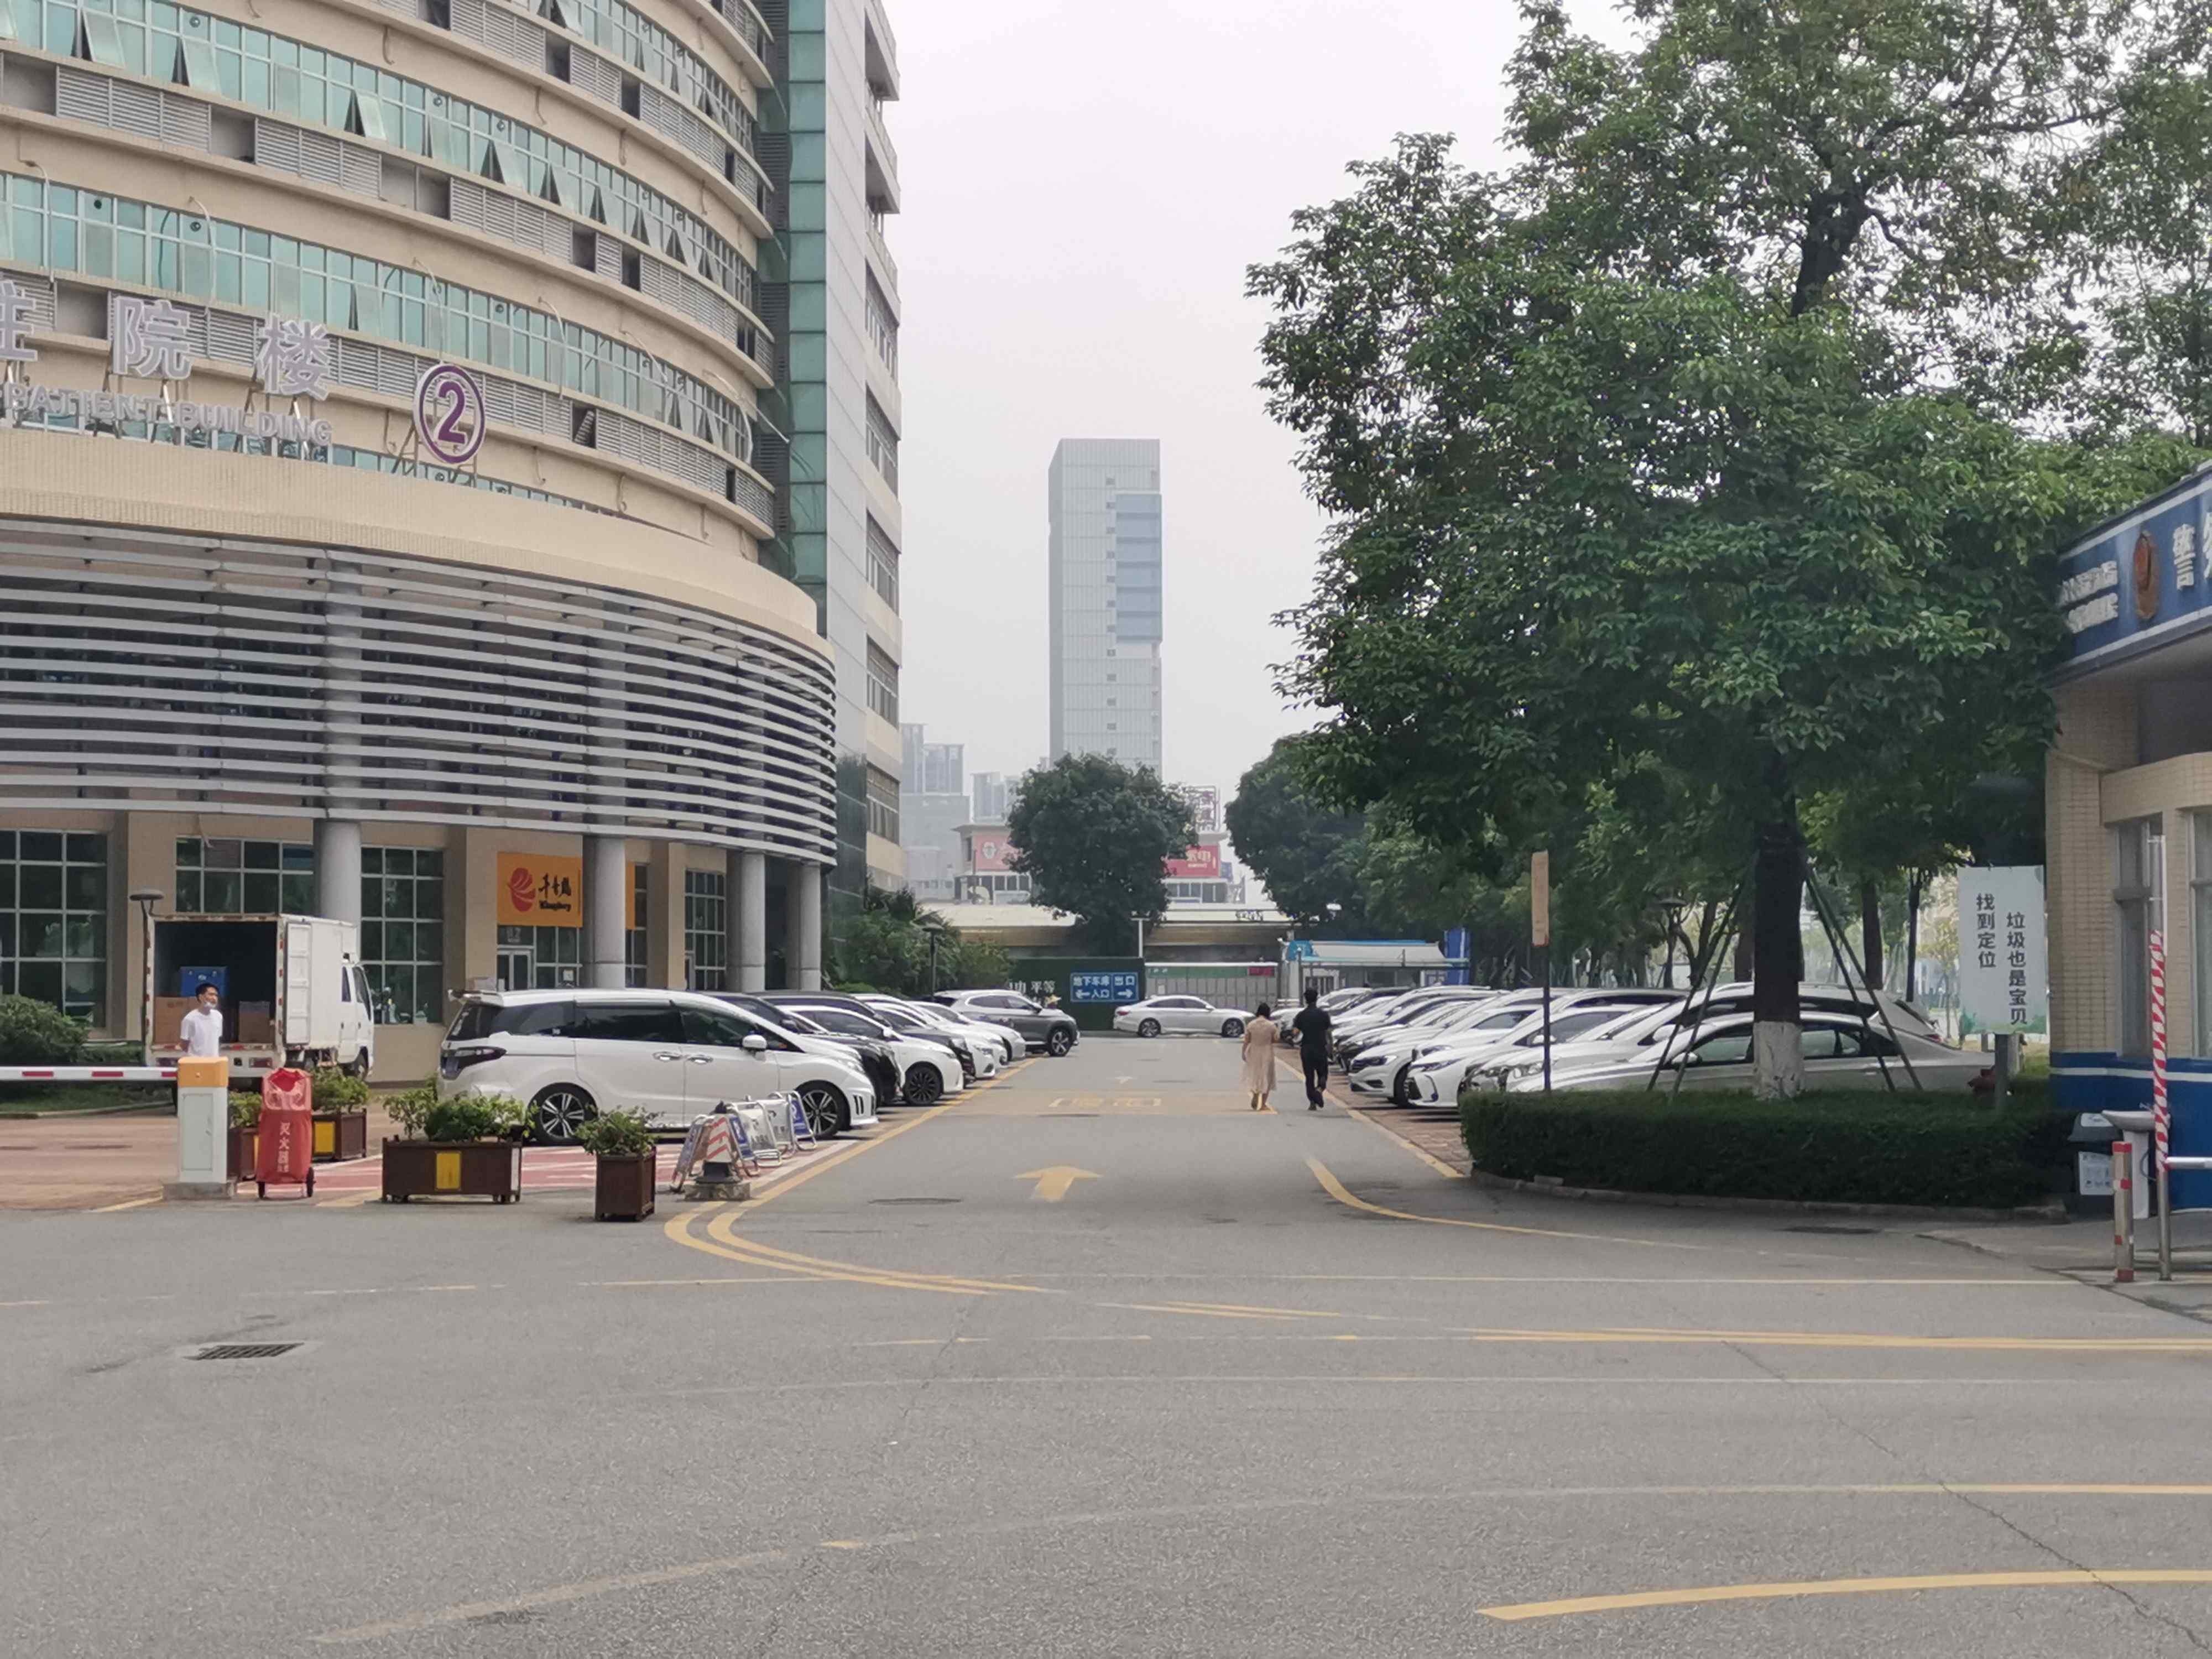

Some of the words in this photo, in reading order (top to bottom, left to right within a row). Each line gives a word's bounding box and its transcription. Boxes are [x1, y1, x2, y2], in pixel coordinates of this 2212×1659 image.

[174, 402, 333, 446] BUILDING
[1976, 894, 1996, 968] 找到定位
[1073, 975, 1109, 987] 地下车库
[1114, 975, 1135, 986] 出口
[2006, 911, 2027, 1024] 垃圾也是宝贝
[1091, 989, 1109, 998] 入口
